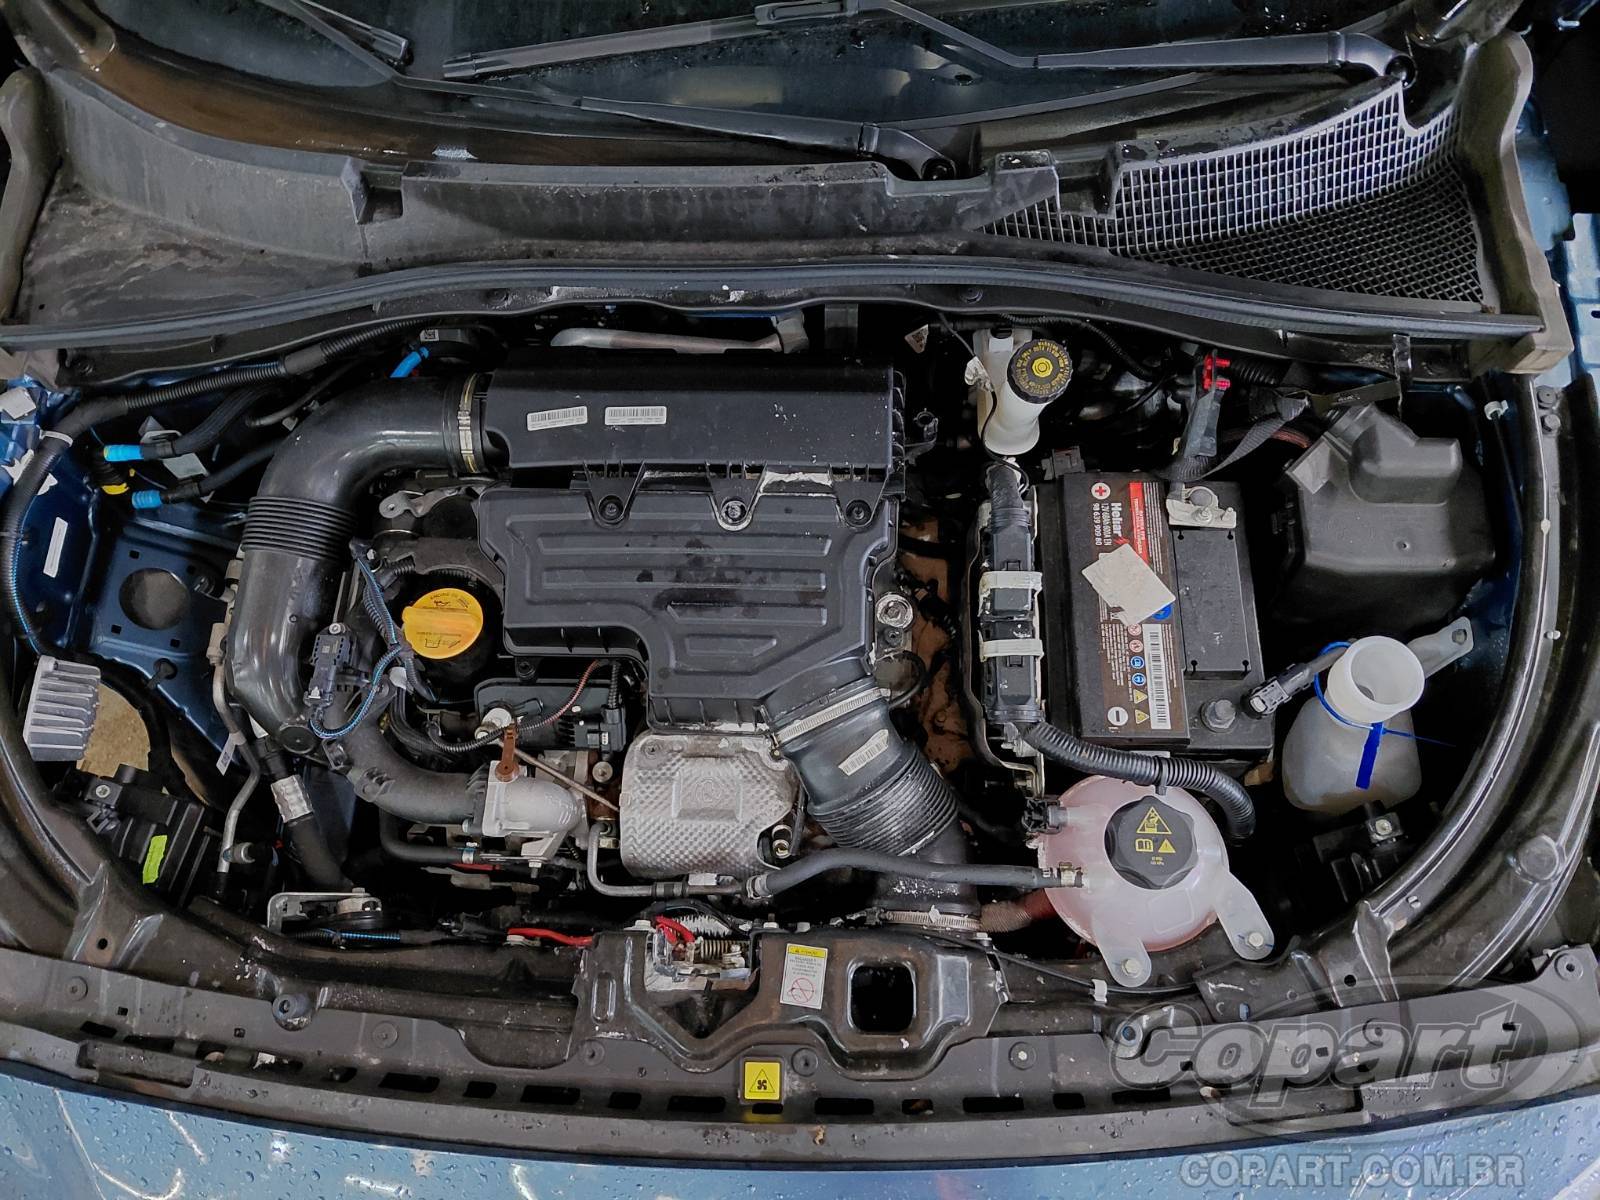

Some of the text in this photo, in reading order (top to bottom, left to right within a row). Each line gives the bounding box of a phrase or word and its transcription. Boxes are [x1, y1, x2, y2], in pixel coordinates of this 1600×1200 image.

[1093, 511, 1101, 523] 639
[1111, 503, 1123, 537] Heliar
[1094, 524, 1102, 536] 909
